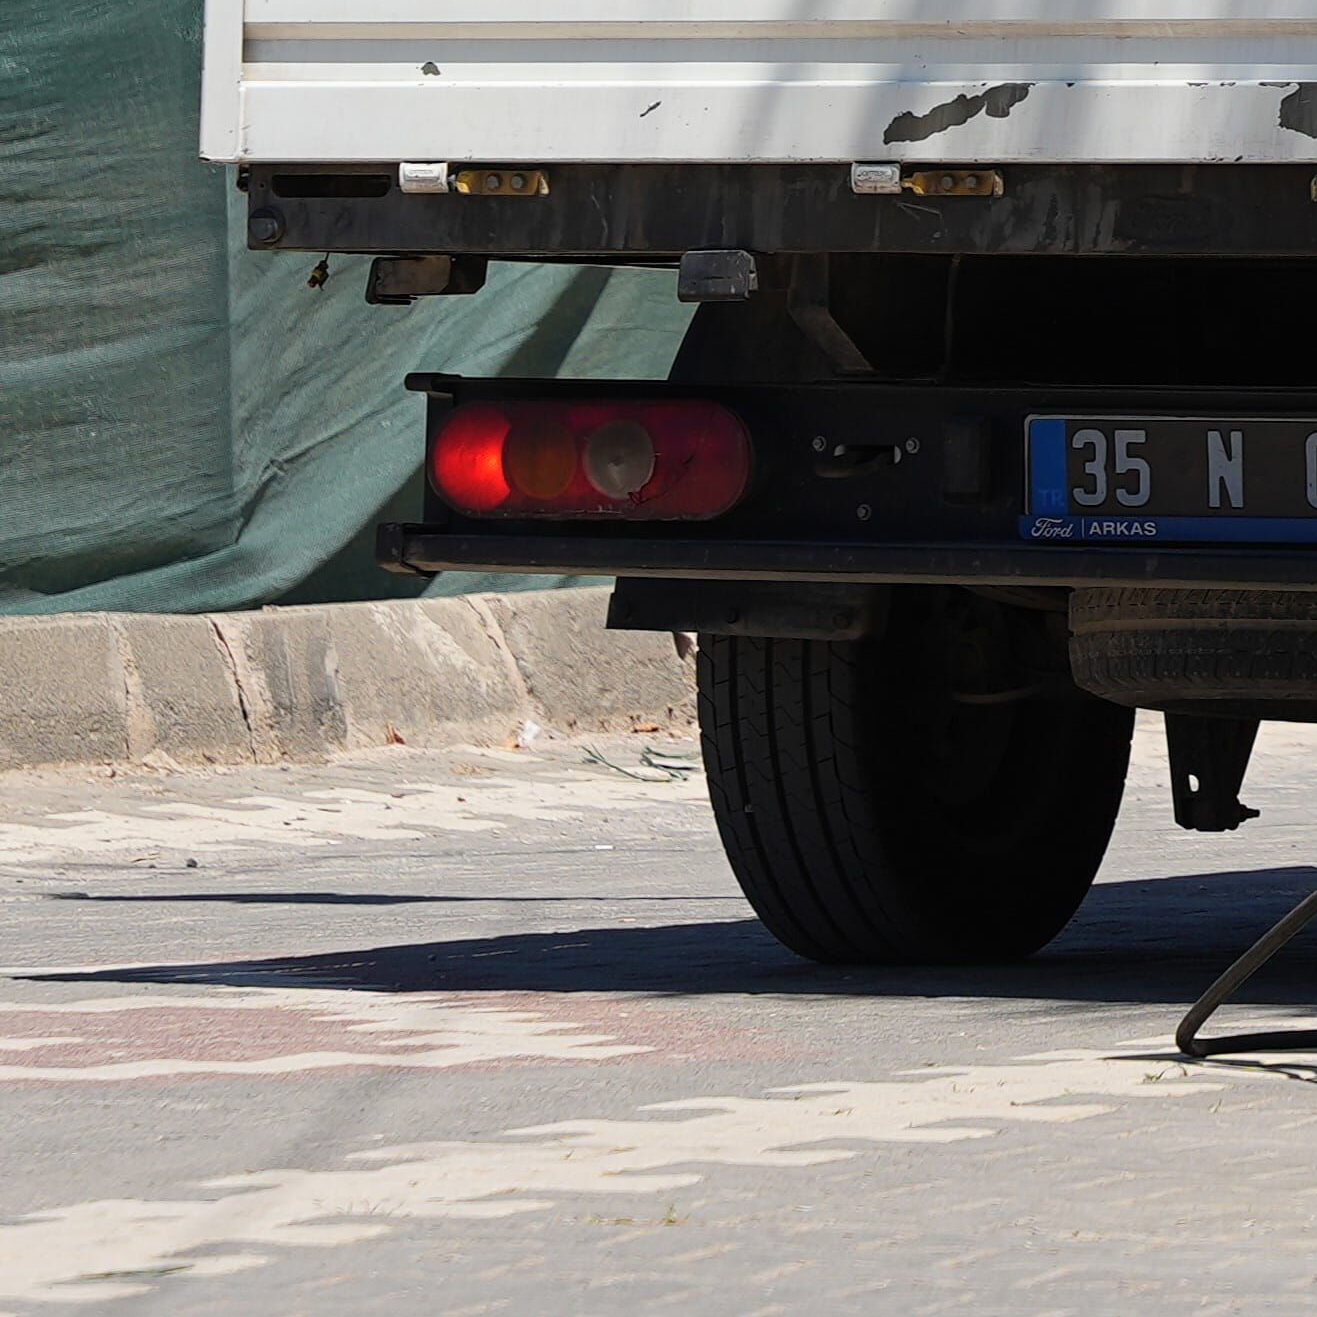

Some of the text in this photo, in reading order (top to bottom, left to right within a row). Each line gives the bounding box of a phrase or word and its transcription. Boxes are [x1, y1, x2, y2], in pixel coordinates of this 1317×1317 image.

[1071, 428, 1152, 509] 35
[1207, 429, 1245, 509] N
[1031, 517, 1158, 539] Ford ARKAS
